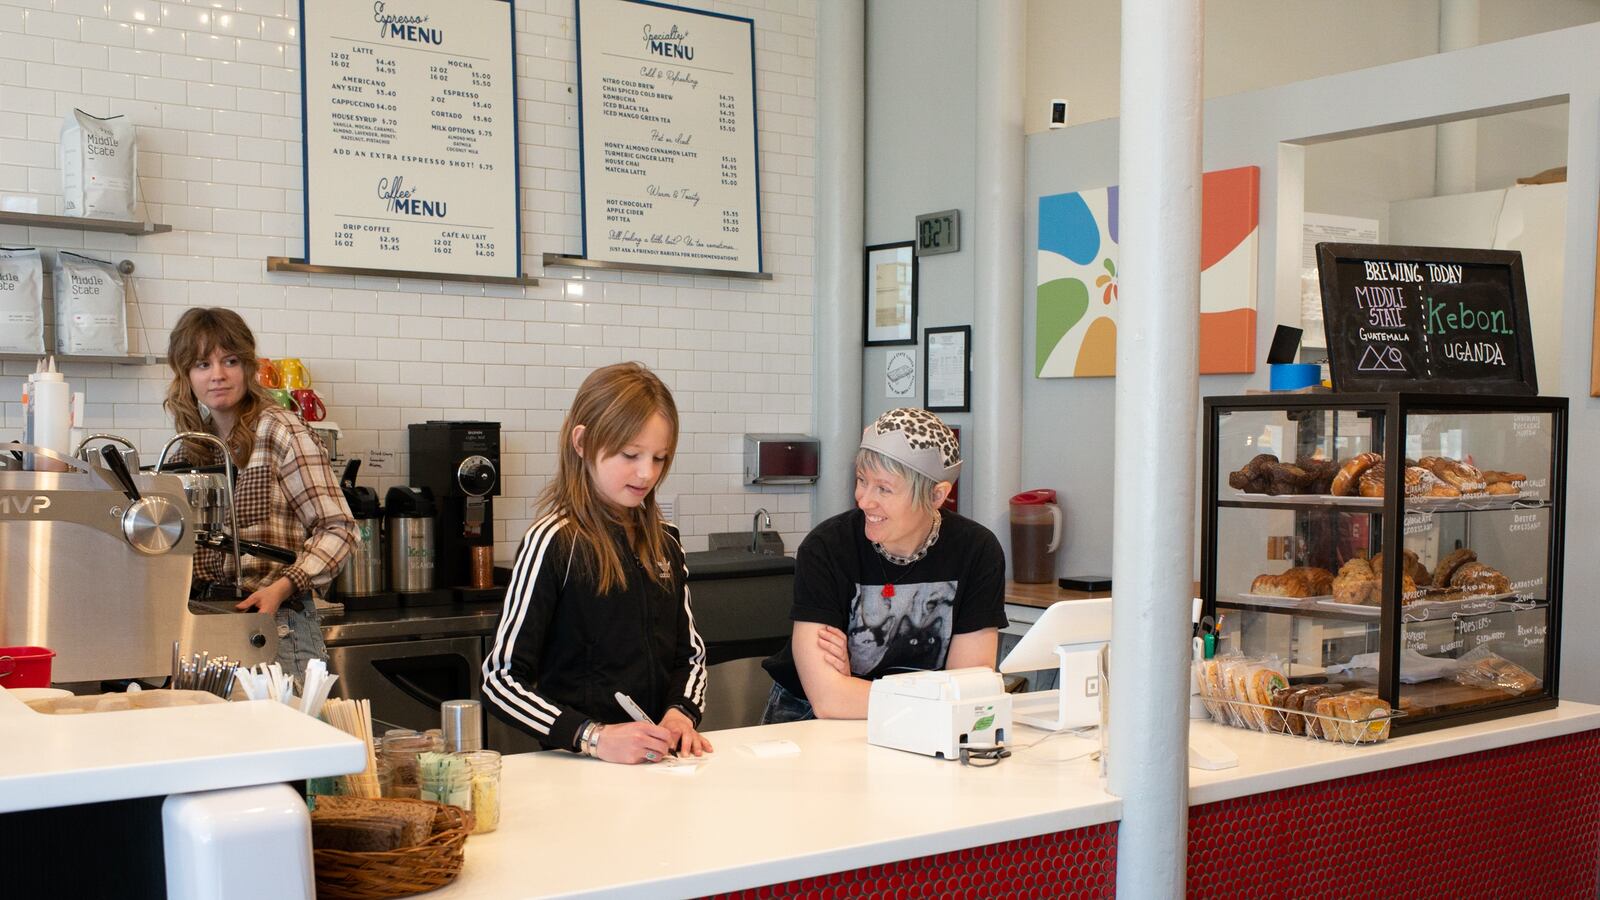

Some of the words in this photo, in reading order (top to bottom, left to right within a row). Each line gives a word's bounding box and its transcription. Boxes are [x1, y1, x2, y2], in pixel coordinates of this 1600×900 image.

[374, 1, 423, 38] Espresso
[391, 23, 443, 45] MENU
[642, 23, 685, 50] Specialty
[352, 47, 374, 55] LATTE
[651, 39, 694, 61] MENU
[376, 58, 396, 67] $4.45
[448, 60, 473, 69] MOCHA
[376, 66, 396, 75] $4.95
[342, 76, 386, 87] AMERICANO
[602, 77, 620, 85] NITRO
[638, 82, 654, 90] BREW
[331, 83, 345, 91] ANY
[347, 85, 362, 93] SIZE
[618, 87, 639, 96] SPICED
[640, 90, 656, 98] COLD
[443, 89, 479, 100] ESPRESSO
[603, 93, 636, 103] KOMBUCHA
[331, 98, 375, 109] CAPPUCCINO
[376, 103, 397, 111] $4.00
[603, 101, 617, 109] ICED
[618, 103, 637, 111] BLACK
[331, 113, 354, 121] HOUSE
[355, 115, 378, 123] SYRUP
[382, 118, 398, 126] $.70
[431, 110, 463, 119] CORTADO
[603, 109, 618, 117] ICED
[618, 111, 640, 120] MANGO
[640, 114, 660, 122] GREEN
[447, 126, 475, 135] OPTIONS
[88, 133, 119, 148] Middle
[88, 144, 115, 157] State
[625, 144, 650, 152] ALMOND
[650, 147, 680, 156] CINNAMON
[370, 152, 398, 160] EXTRA
[402, 155, 446, 166] ESPRESSO
[449, 160, 474, 169] SHOT!
[605, 150, 634, 159] TURMERIC
[635, 153, 657, 161] GINGER
[658, 156, 674, 164] LATTE
[605, 158, 624, 166] HOUSE
[605, 166, 629, 174] MATCHA
[378, 175, 412, 212] Coffee
[395, 198, 447, 218] MENU
[619, 200, 653, 209] CHOCOLATE
[343, 223, 361, 231] DRIP
[363, 225, 391, 234] COFFEE
[471, 233, 487, 241] LAIT
[475, 249, 495, 257] $4.00
[691, 253, 739, 261] RECOMMENDATIONS!
[1363, 260, 1424, 282] BREWING
[1425, 263, 1463, 284] TODAY
[71, 274, 104, 286] Middle
[72, 284, 100, 295] State
[1355, 286, 1407, 309] MIDDLE
[1369, 307, 1407, 328] STATE
[1359, 327, 1410, 342] GUATEMALA
[1443, 341, 1506, 366] UGANDA
